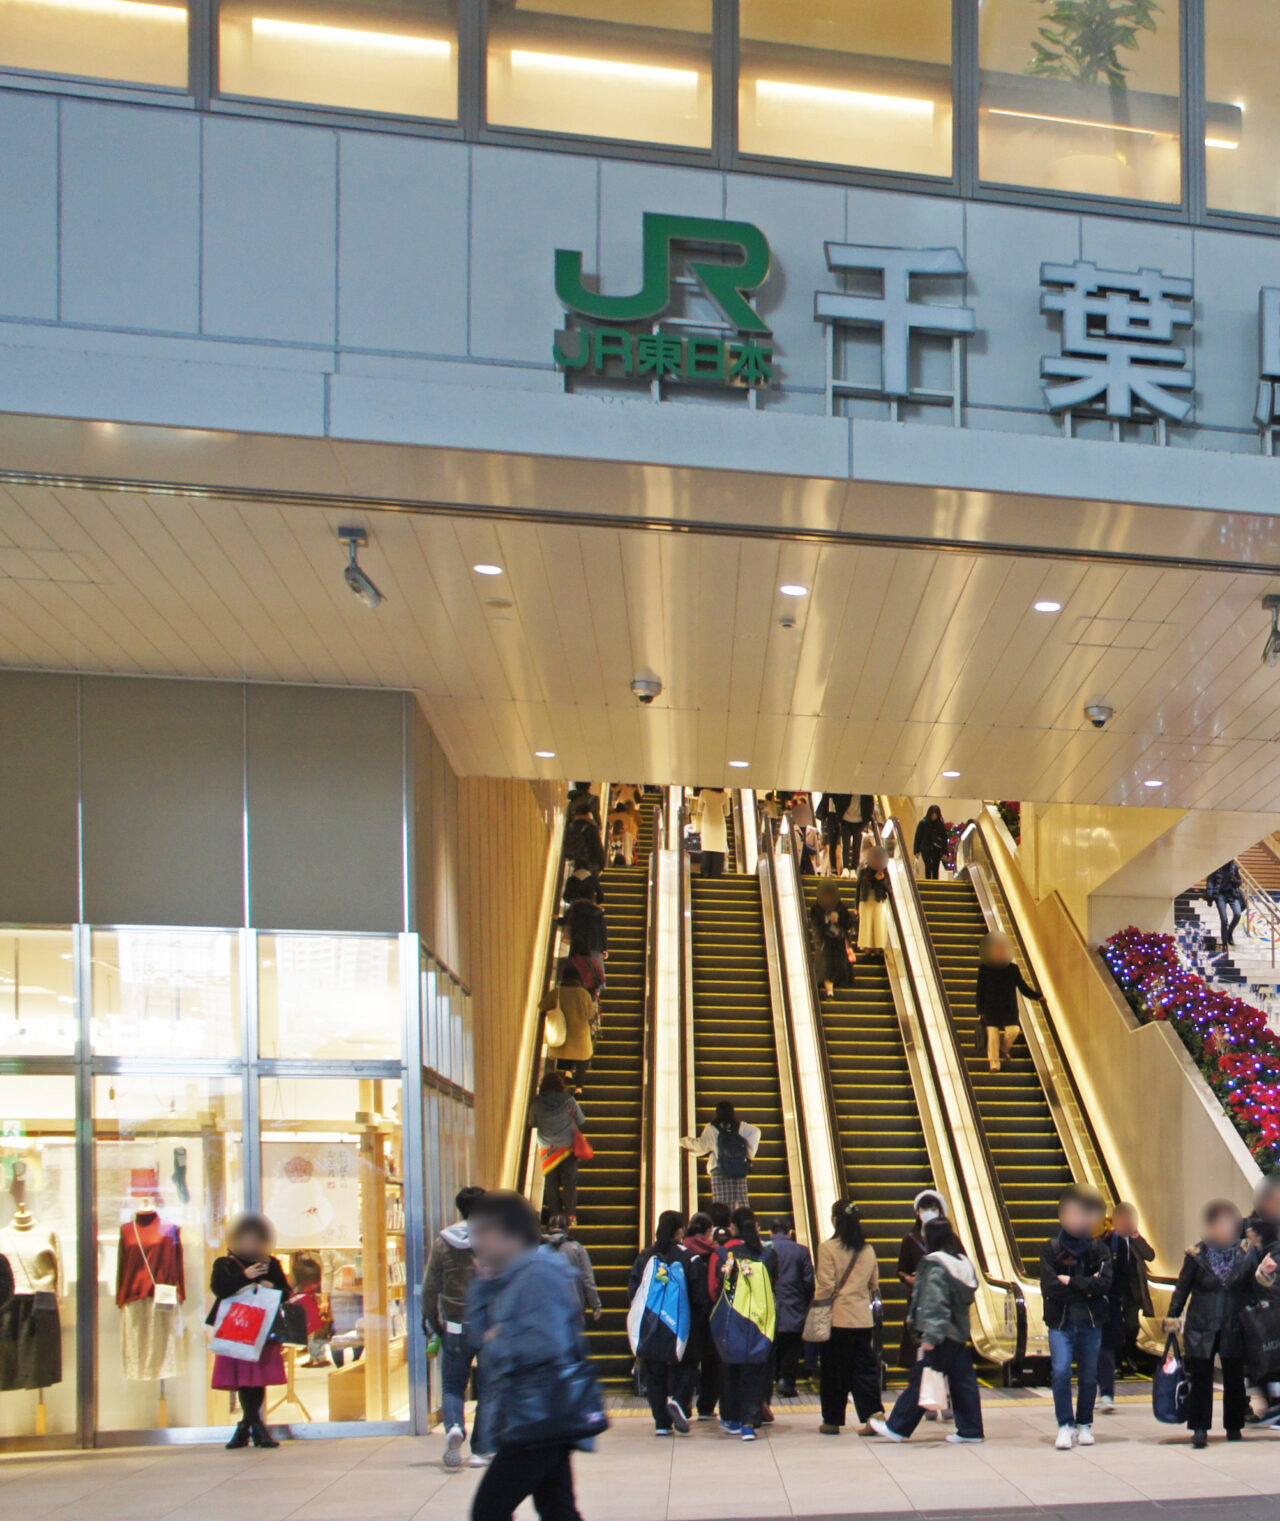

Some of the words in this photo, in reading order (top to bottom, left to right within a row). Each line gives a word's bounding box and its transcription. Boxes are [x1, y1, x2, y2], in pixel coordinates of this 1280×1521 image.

[554, 212, 771, 333] JR
[552, 327, 774, 384] JR東日本
